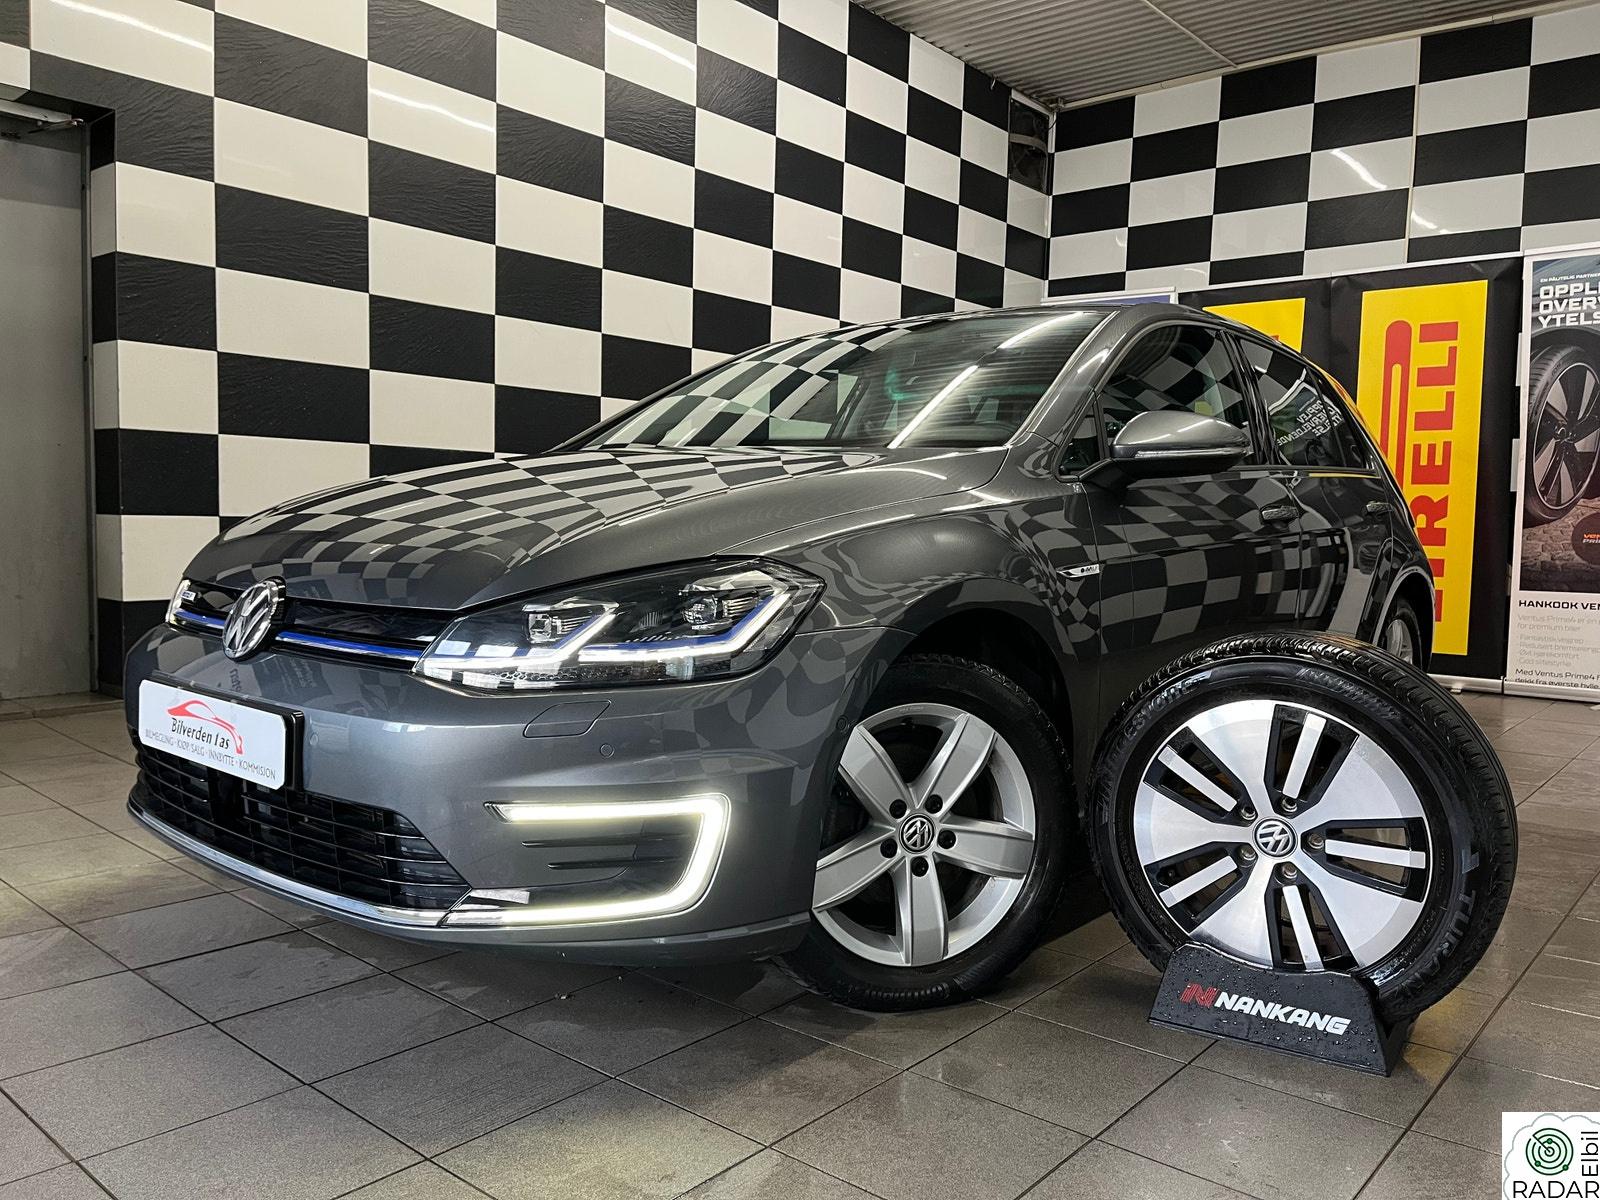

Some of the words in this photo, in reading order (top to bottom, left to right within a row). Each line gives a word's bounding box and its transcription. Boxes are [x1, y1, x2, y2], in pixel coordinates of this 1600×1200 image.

[1540, 282, 1600, 299] OPPL
[1519, 600, 1579, 610] HANKOOK
[1581, 602, 1600, 611] VE
[1515, 668, 1533, 676] Med
[1534, 669, 1563, 678] Ventus
[171, 717, 213, 744] Bilverden
[1214, 991, 1351, 1036] NANKANG
